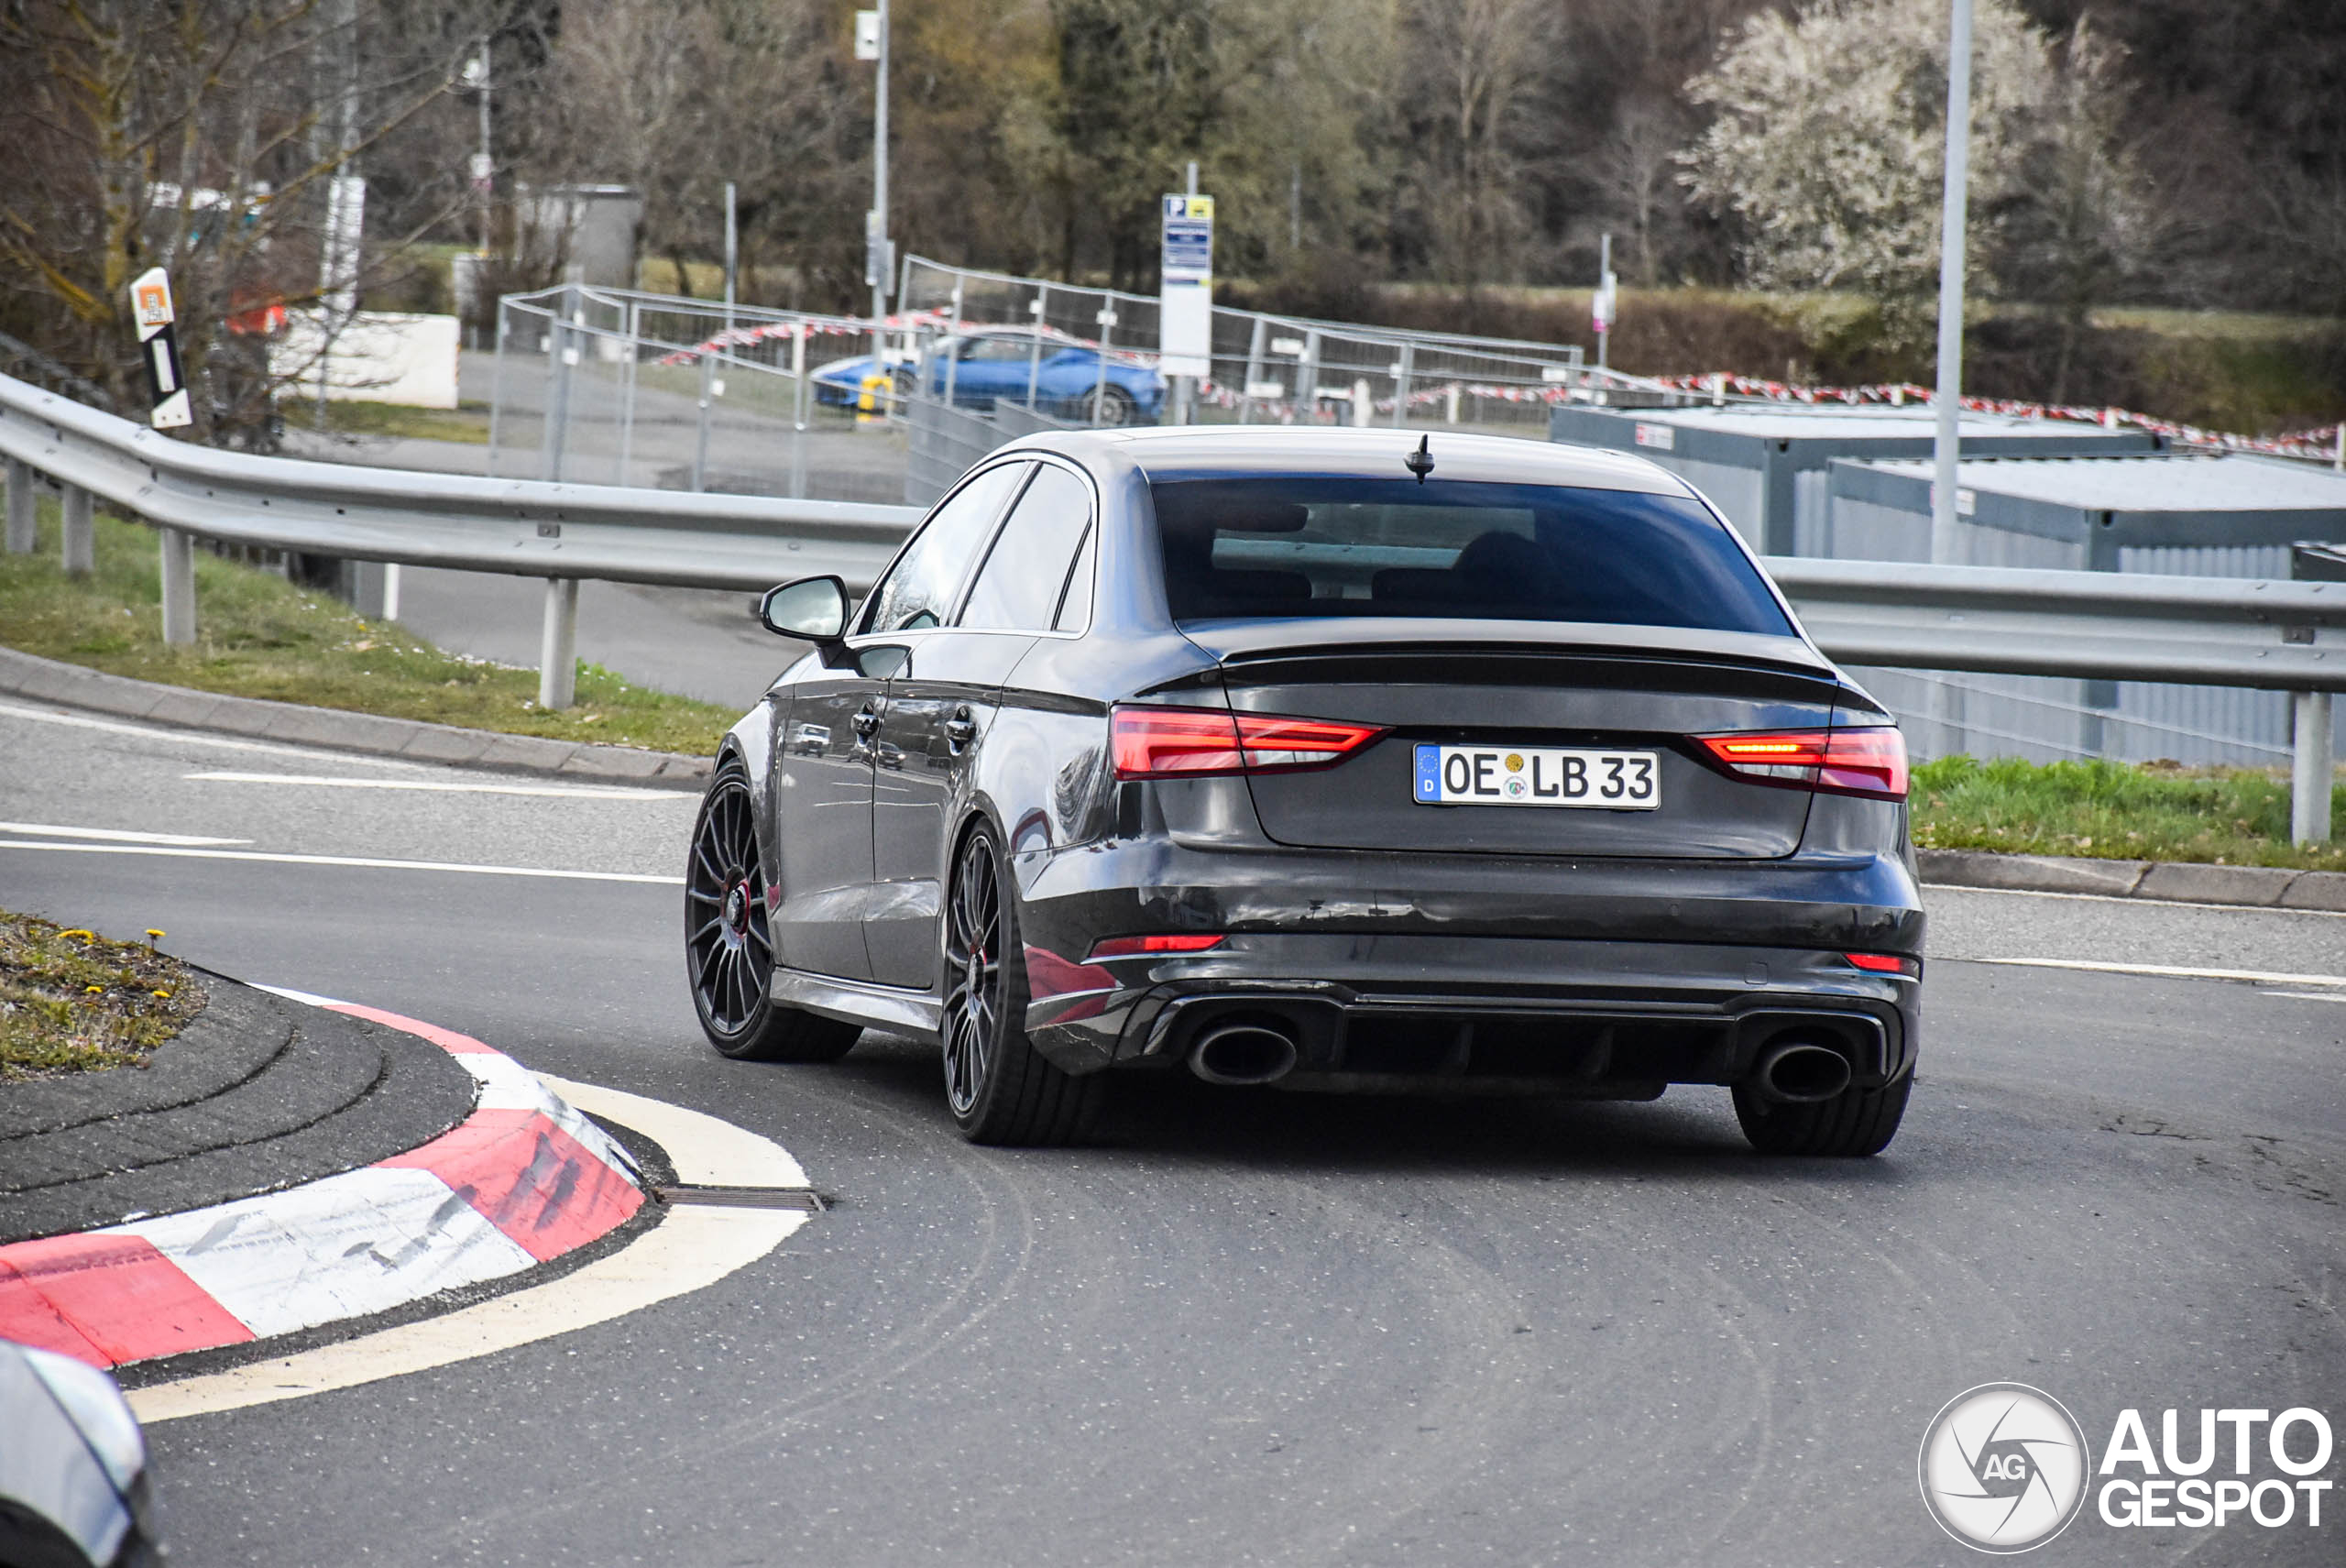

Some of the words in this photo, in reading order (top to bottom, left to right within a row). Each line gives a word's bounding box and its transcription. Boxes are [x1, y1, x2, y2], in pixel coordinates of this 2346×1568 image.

[1424, 780, 1434, 792] D
[1444, 753, 1500, 795] OE
[1532, 755, 1589, 797] LB
[1600, 757, 1653, 799] 33
